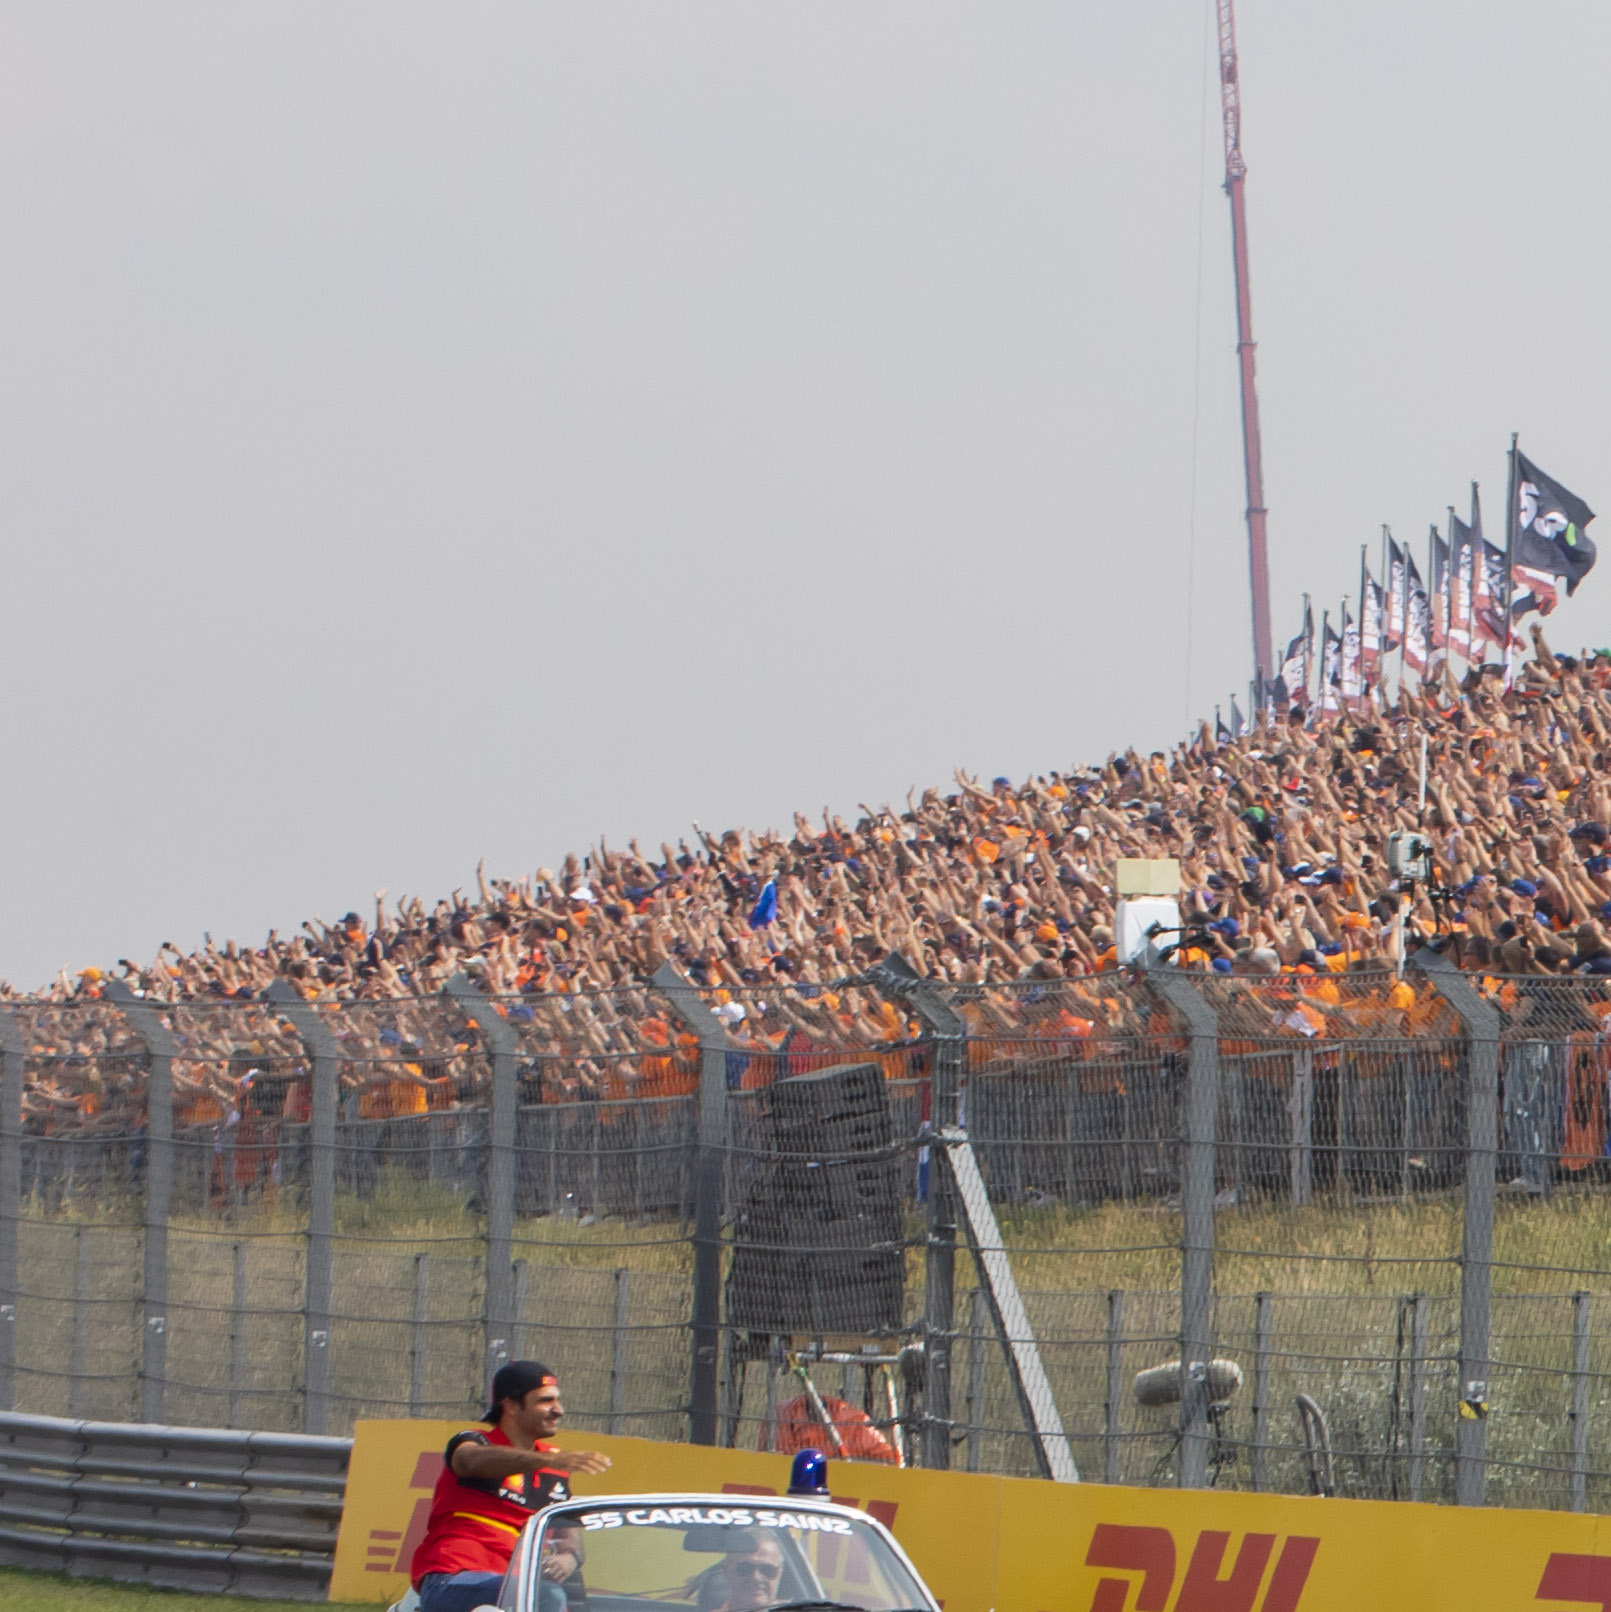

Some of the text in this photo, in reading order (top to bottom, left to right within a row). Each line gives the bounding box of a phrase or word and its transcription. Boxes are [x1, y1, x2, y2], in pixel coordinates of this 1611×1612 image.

[579, 1509, 853, 1535] 55 CARLOS SAINZ
